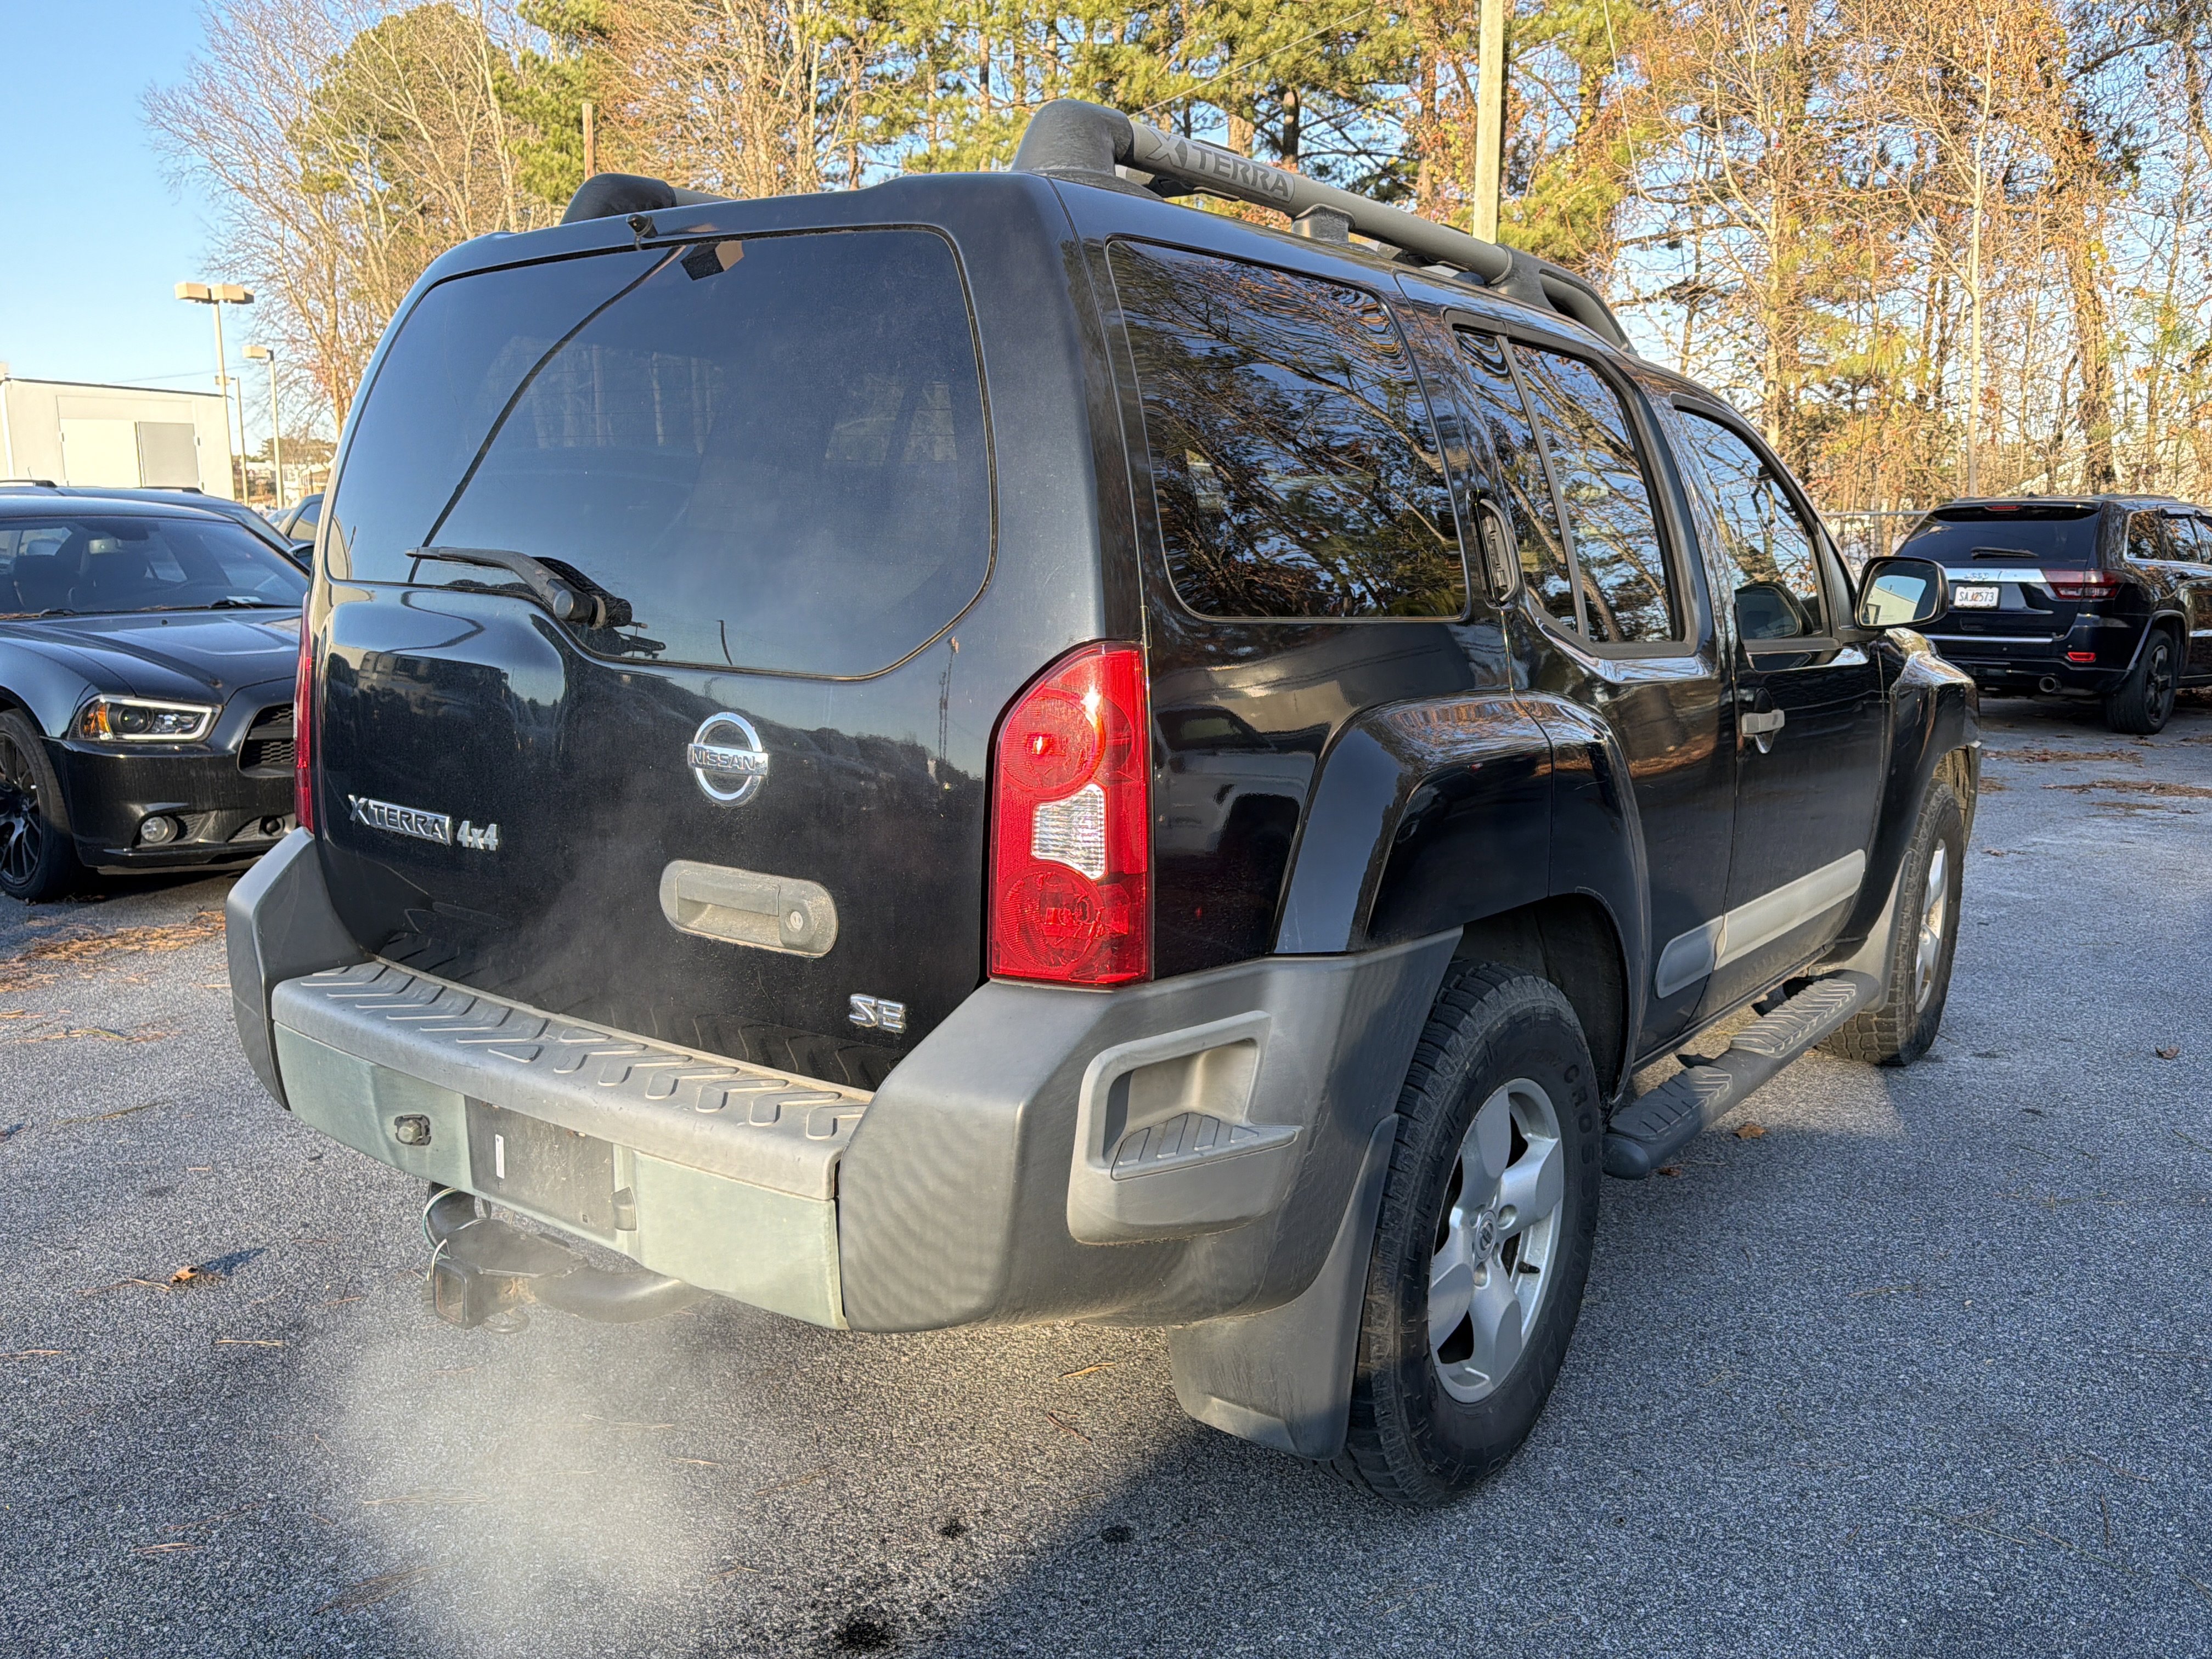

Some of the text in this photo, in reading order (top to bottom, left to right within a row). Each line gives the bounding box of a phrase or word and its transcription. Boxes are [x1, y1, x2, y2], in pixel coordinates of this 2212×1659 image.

[1145, 126, 1294, 203] XTERRA
[691, 747, 756, 771] NISSAN
[348, 794, 499, 850] XTERRA 4x4
[849, 993, 906, 1033] SE
